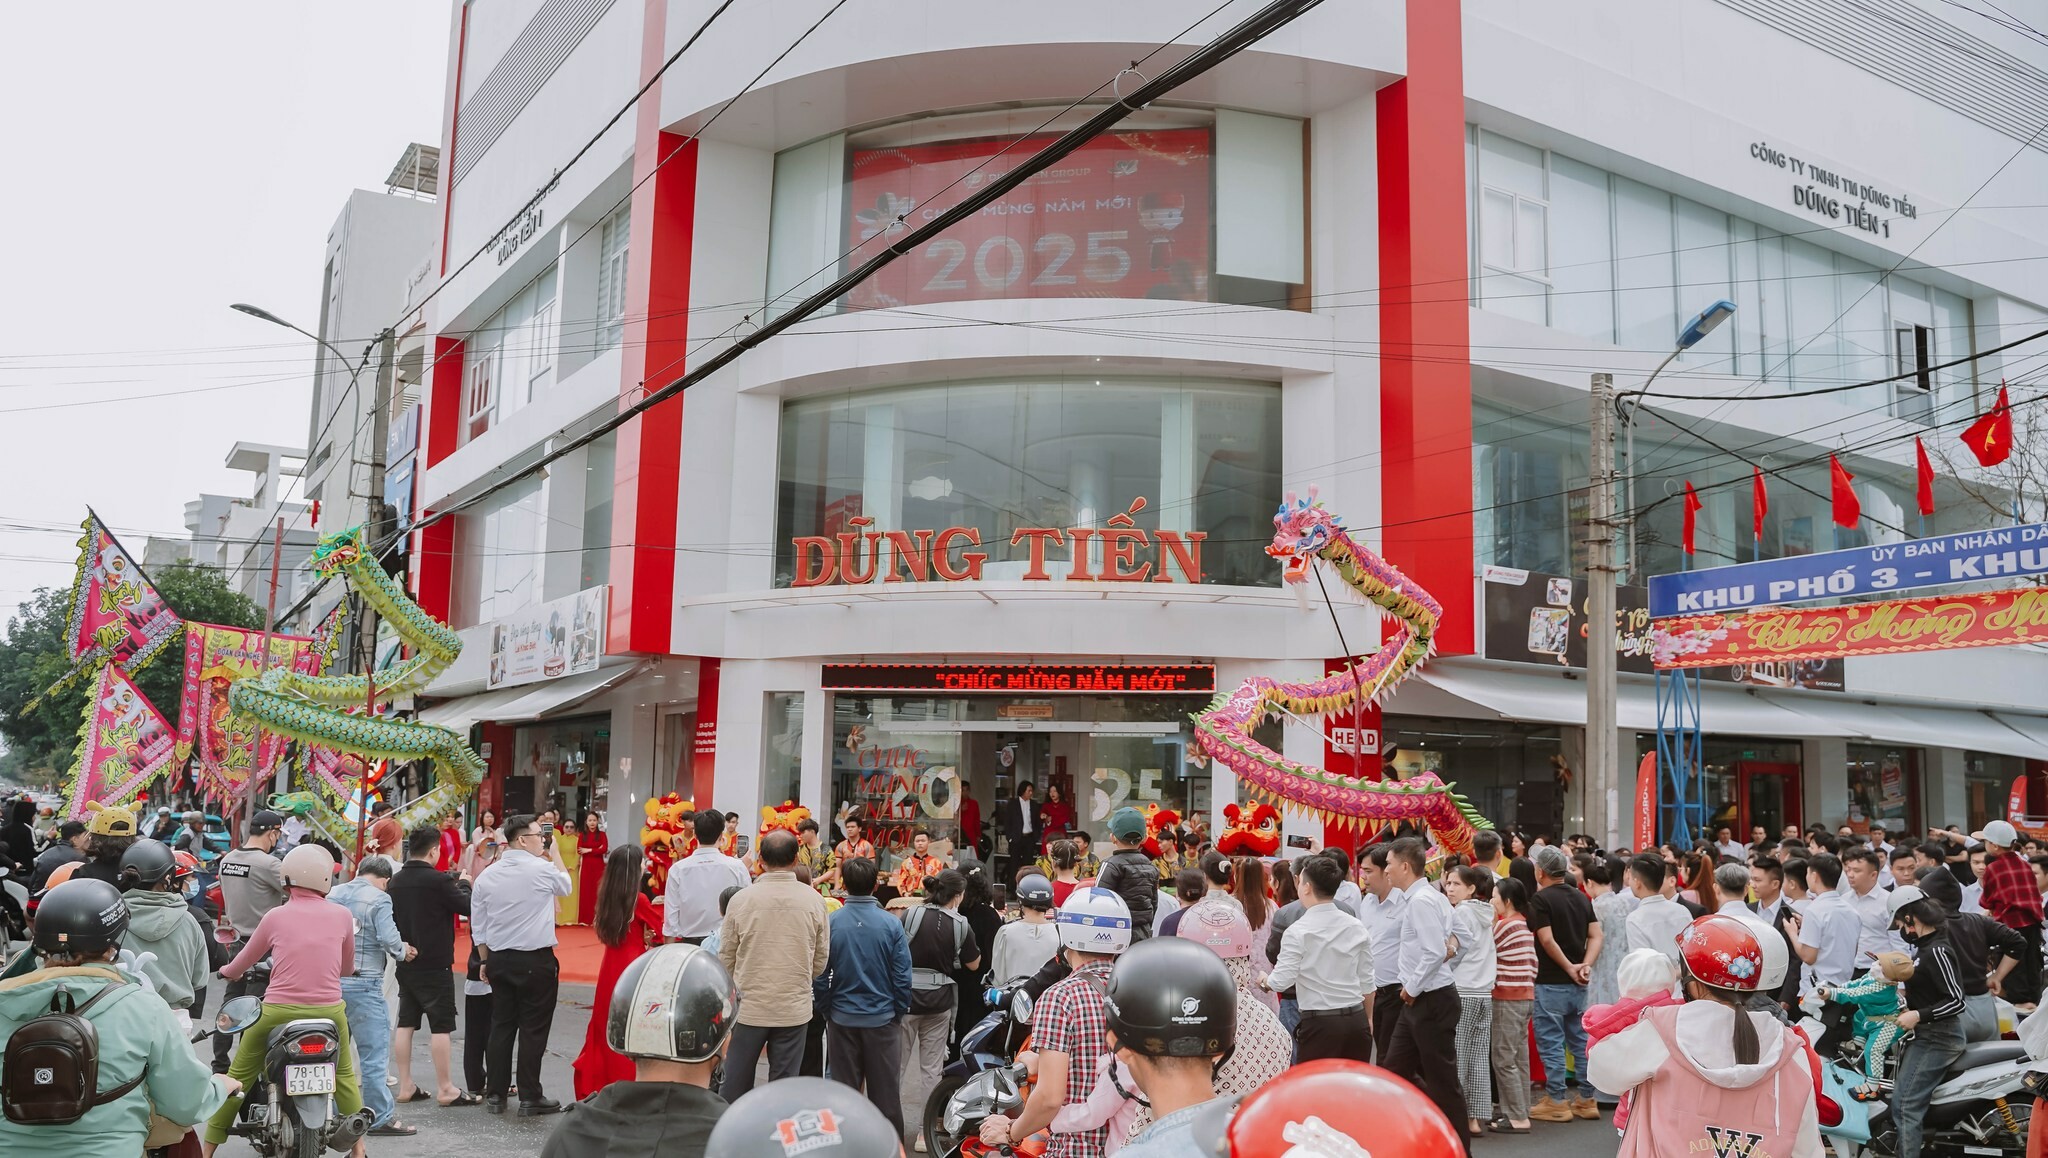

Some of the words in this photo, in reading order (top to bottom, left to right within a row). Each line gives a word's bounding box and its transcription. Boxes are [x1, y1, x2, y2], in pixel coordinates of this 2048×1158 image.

[1052, 168, 1092, 178] GROUP
[1750, 142, 1786, 168] CÔNG
[1789, 157, 1805, 175] TY
[1808, 165, 1839, 189] TNHH
[1842, 178, 1858, 197] TM
[1860, 185, 1890, 209] DŨNG
[1893, 194, 1917, 220] TIẾN
[983, 201, 1035, 216] MỪNG
[1046, 198, 1086, 213] NĂM
[1095, 195, 1132, 210] MỚI
[1794, 185, 1839, 219] DŨNG
[1844, 202, 1879, 235] TIẾN
[1883, 220, 1890, 239] 1
[923, 230, 1132, 291] 2025
[791, 516, 988, 587] DŨNG
[1010, 497, 1208, 584] TIẾN
[1872, 547, 1897, 562] ỦY
[1904, 541, 1945, 558] BAN
[1954, 532, 2012, 551] NHÂN
[1678, 585, 1755, 611] KHU
[1769, 566, 1856, 600] PHỐ
[1871, 567, 1898, 588] 3
[1748, 614, 1843, 652] Chúc
[1846, 601, 1977, 643] Mừng
[936, 669, 1001, 689] "CHÚC
[1007, 669, 1070, 690] MỪNG
[1077, 669, 1123, 689] NĂM
[1131, 669, 1186, 690] MỚI"
[858, 744, 929, 769] CHÚC
[855, 770, 928, 795] MỪNG
[290, 1079, 332, 1092] 534.36
[294, 1066, 326, 1079] 78-C1
